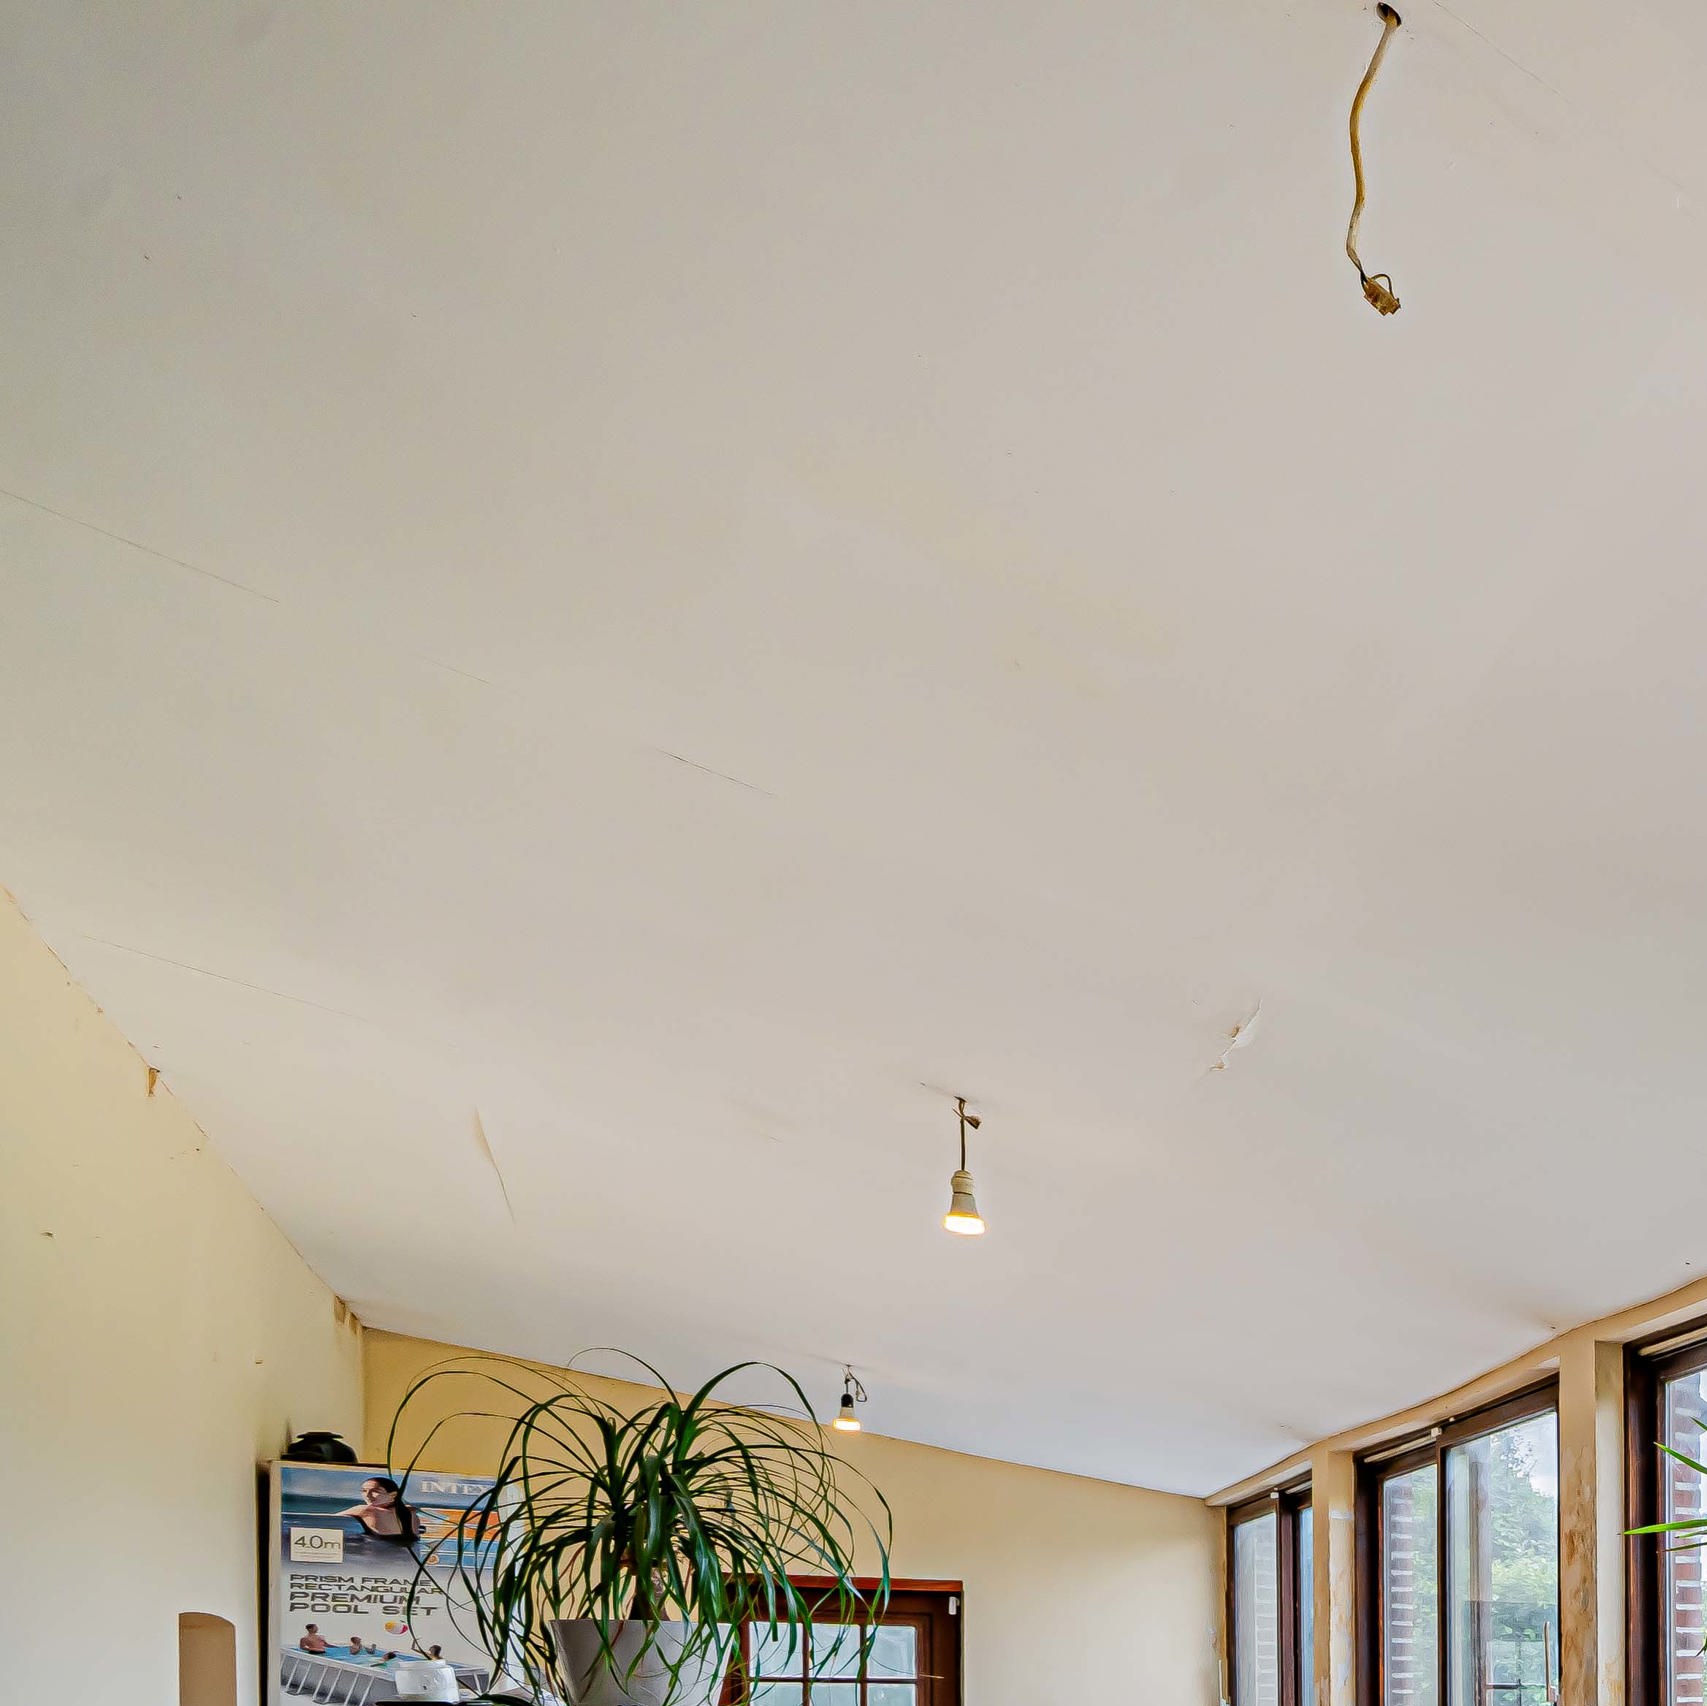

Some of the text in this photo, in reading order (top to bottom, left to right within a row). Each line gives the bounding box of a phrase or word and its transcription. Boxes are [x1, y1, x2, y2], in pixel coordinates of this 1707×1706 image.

[289, 1573, 431, 1587] PRISM FRAME
[289, 1591, 420, 1605] PREMIUM
[289, 1602, 438, 1616] POOL SET
